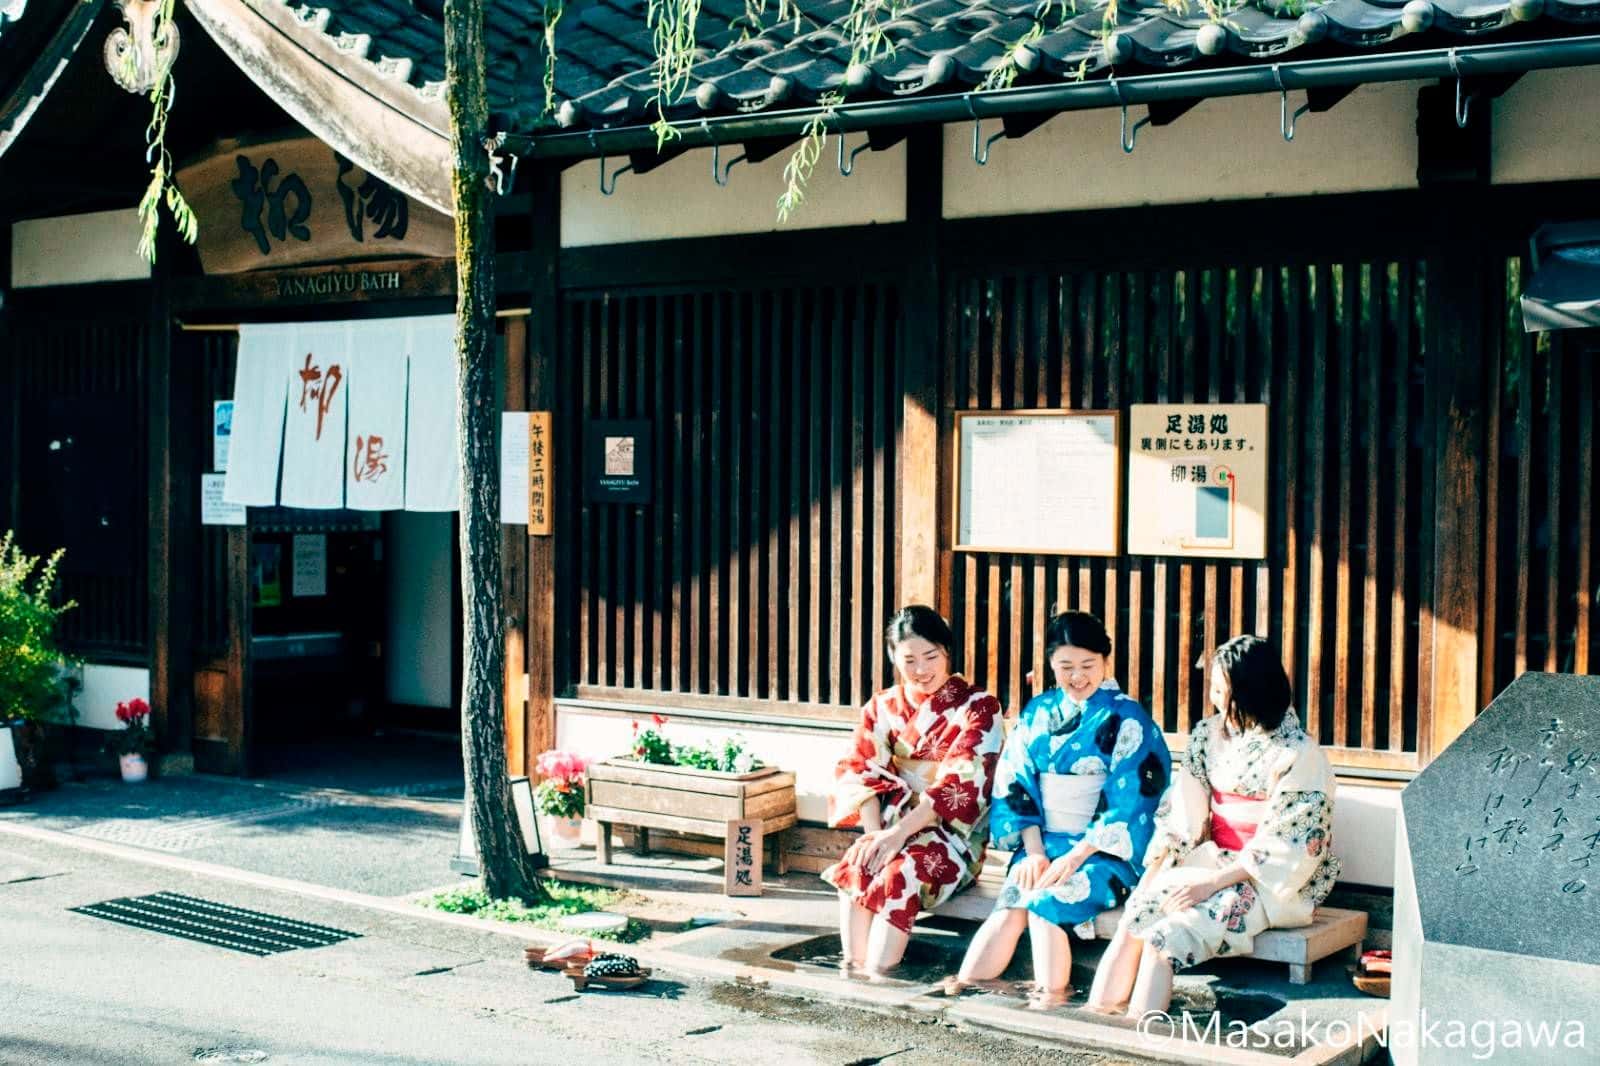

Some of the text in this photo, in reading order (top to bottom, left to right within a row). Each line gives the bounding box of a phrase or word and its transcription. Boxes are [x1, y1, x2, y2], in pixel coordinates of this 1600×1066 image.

[275, 272, 400, 297] YANAGIYU BATH
[1165, 413, 1229, 435] 足湯処
[1140, 437, 1255, 452] 裏側にもあります。
[1171, 464, 1207, 483] 柳湯
[735, 826, 753, 885] 足湯処
